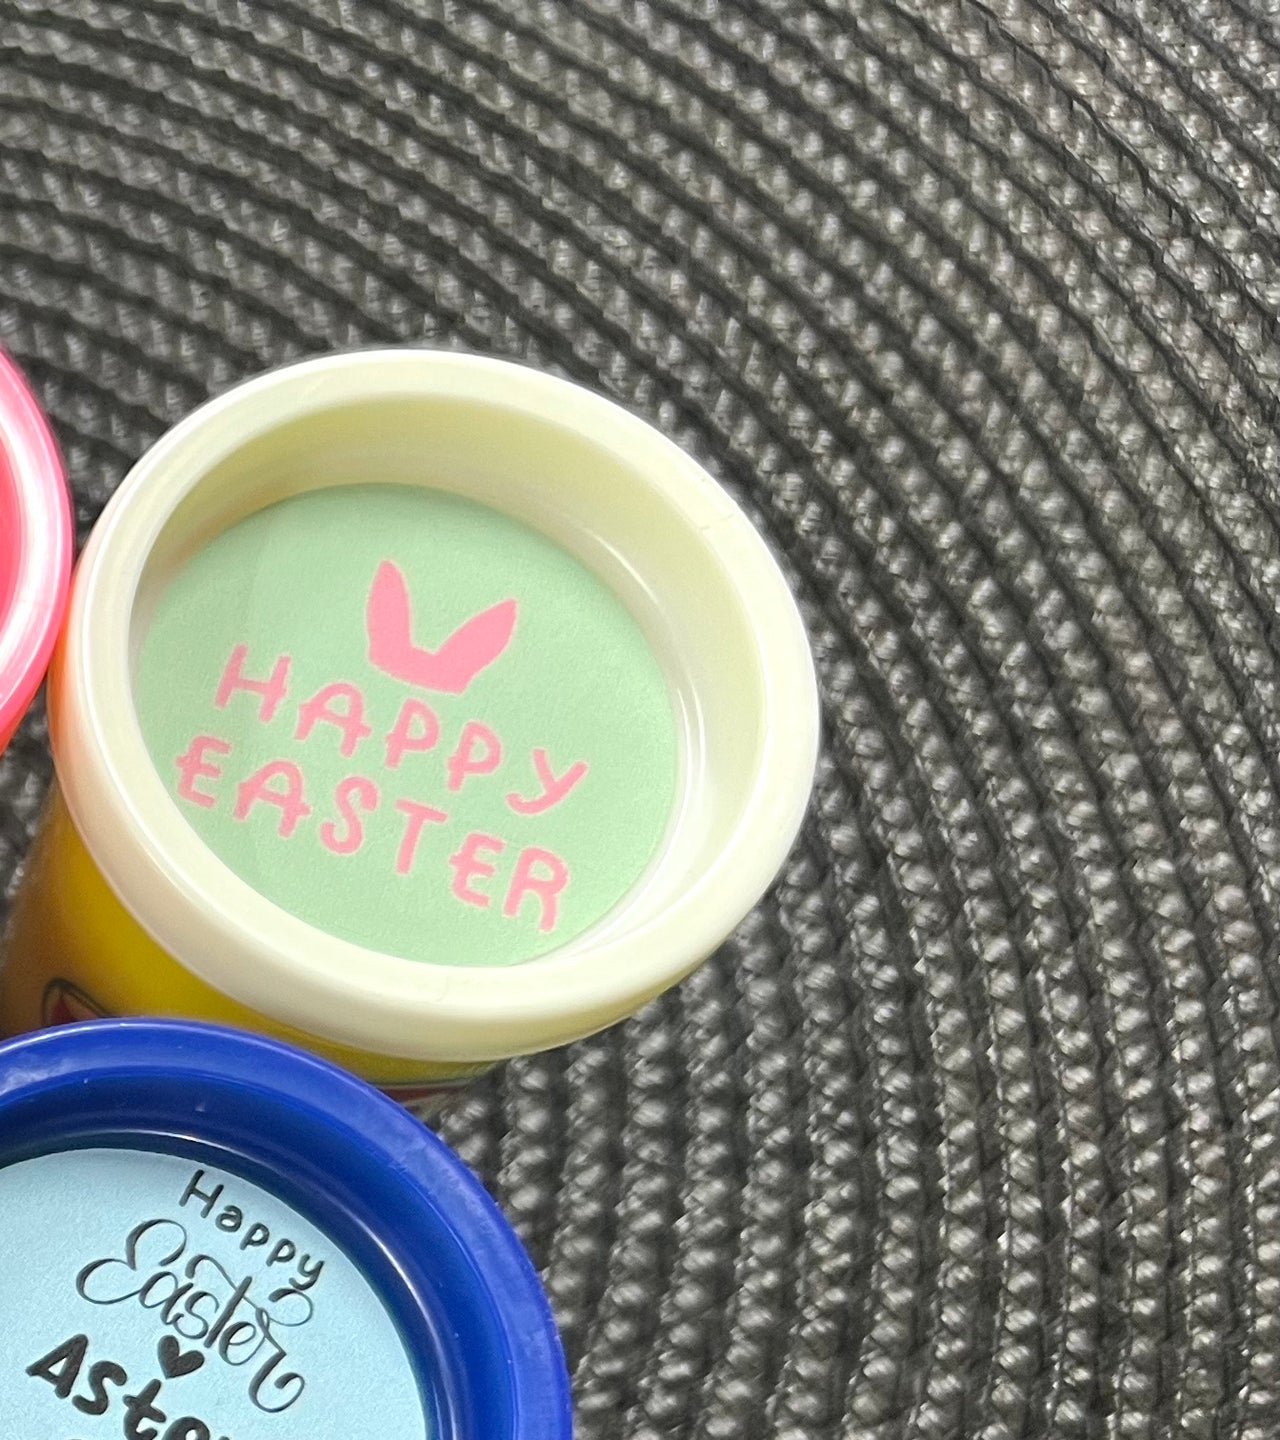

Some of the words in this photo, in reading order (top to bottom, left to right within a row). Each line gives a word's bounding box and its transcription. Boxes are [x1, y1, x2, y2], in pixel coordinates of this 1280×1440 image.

[215, 644, 588, 815] HAPPY
[176, 735, 570, 932] EASTER
[76, 1218, 314, 1413] Easter
[179, 1169, 325, 1291] Happy
